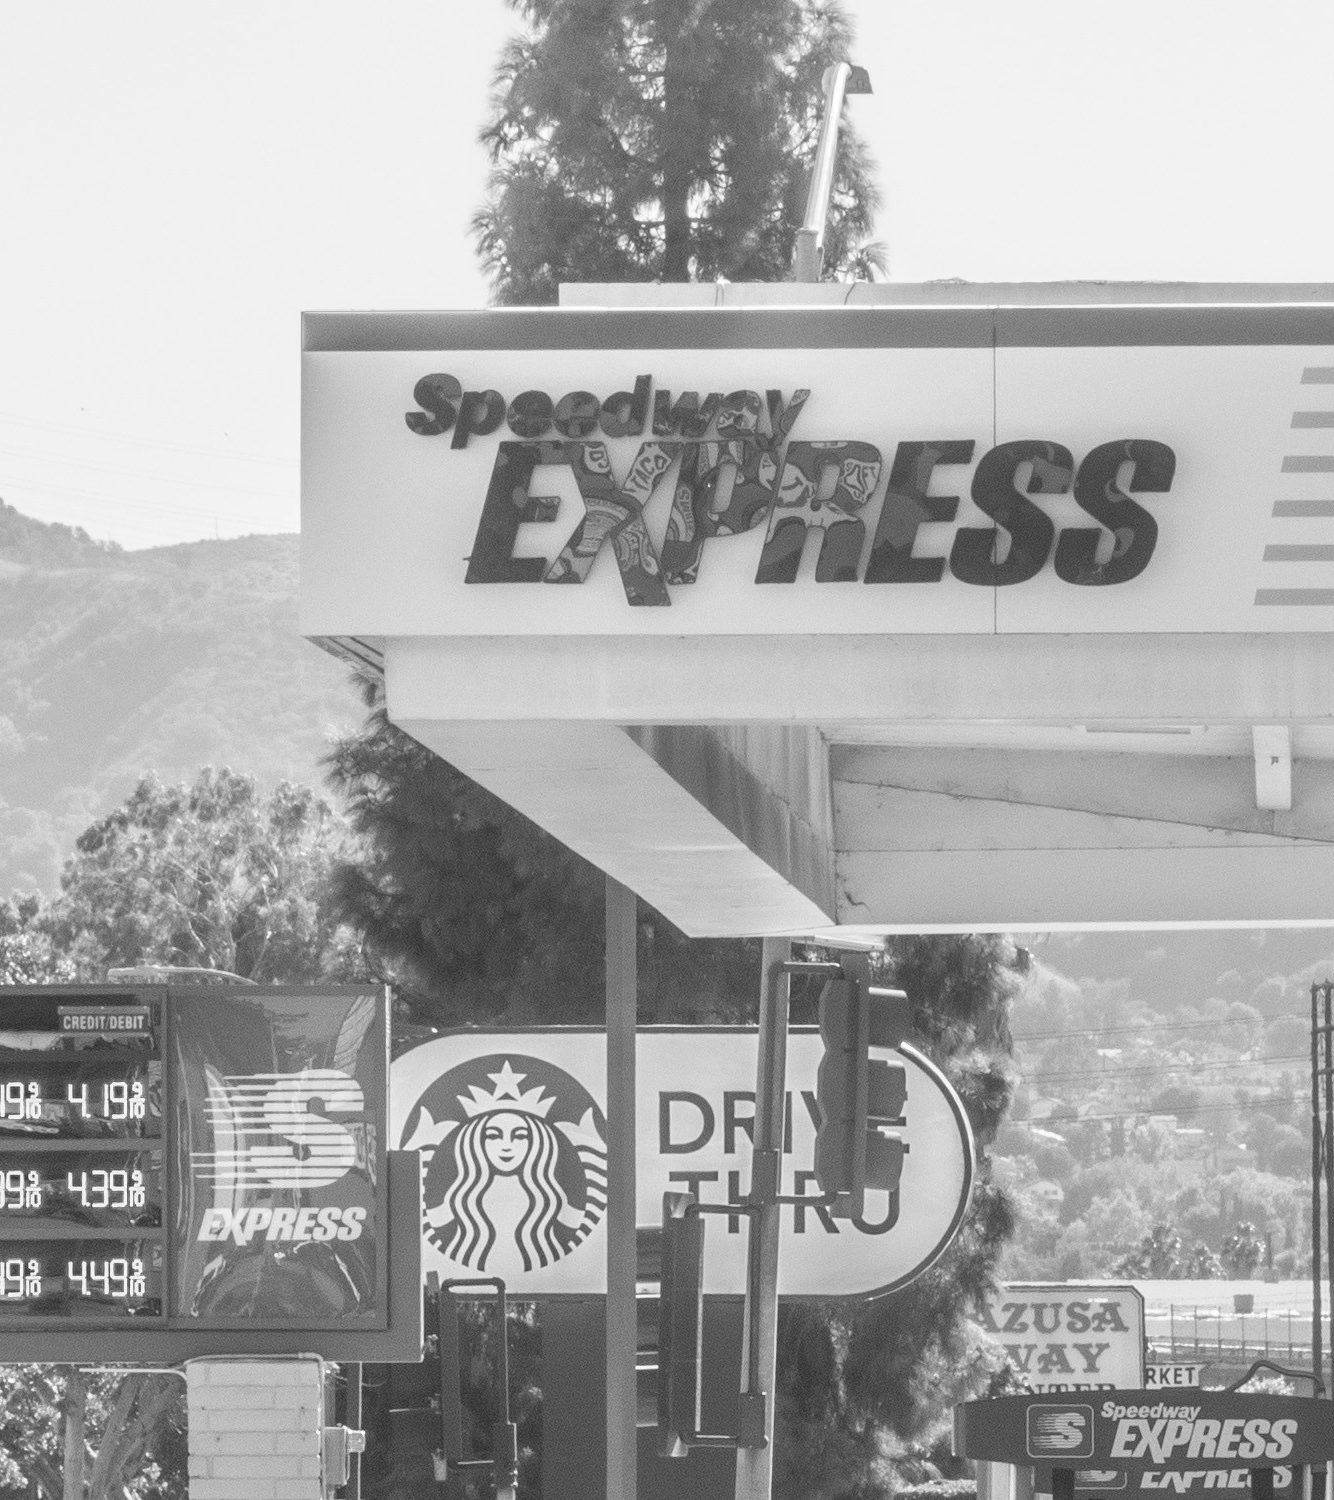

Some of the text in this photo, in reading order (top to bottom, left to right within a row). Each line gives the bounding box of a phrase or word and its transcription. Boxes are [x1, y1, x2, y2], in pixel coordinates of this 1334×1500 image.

[405, 373, 811, 452] Speedway
[464, 438, 1178, 606] EXPRESS
[62, 1015, 145, 1031] CREDIT/DEBIT
[196, 1206, 367, 1247] EXPRESS
[1146, 1366, 1196, 1385] RKET
[1101, 1401, 1201, 1423] Speedway
[1110, 1419, 1298, 1464] EXPRESS
